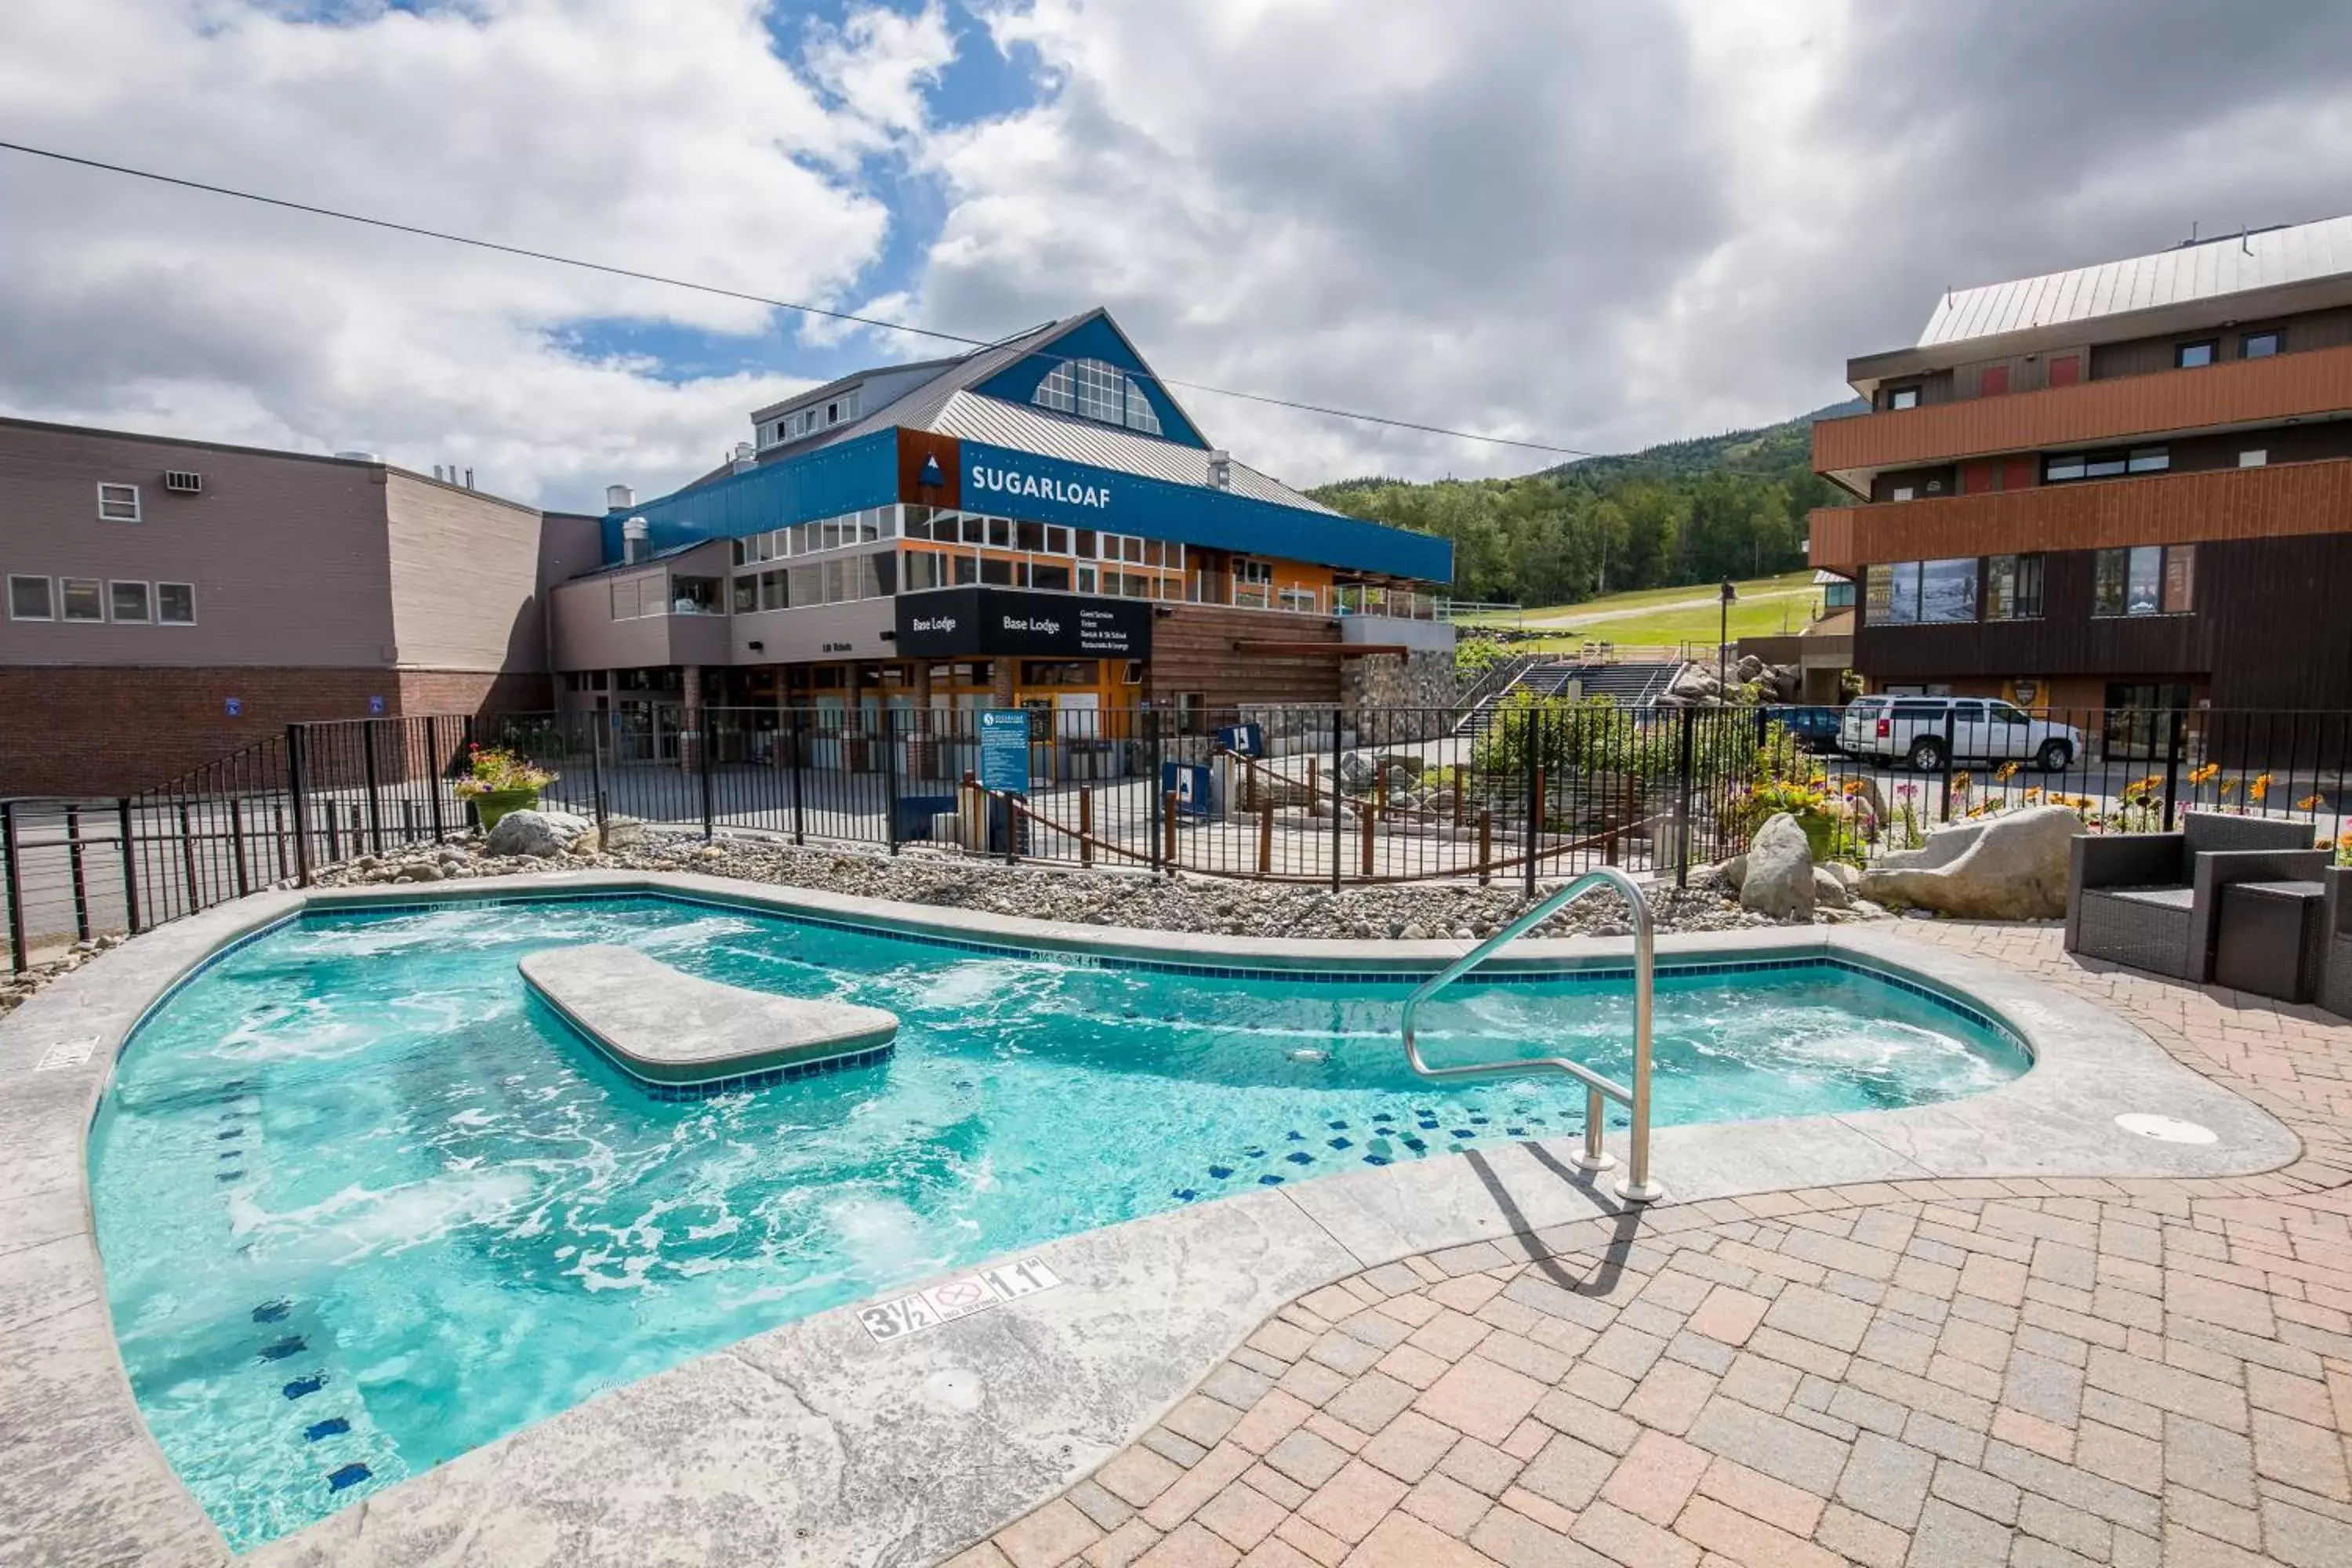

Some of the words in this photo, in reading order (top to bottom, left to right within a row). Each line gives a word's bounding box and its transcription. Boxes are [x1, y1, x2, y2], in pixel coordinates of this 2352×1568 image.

[972, 465, 1110, 509] SUGARLOAF
[913, 618, 931, 631] Base
[931, 615, 956, 632] Lodge
[1003, 615, 1028, 630] Base
[1029, 617, 1060, 634] Lodge
